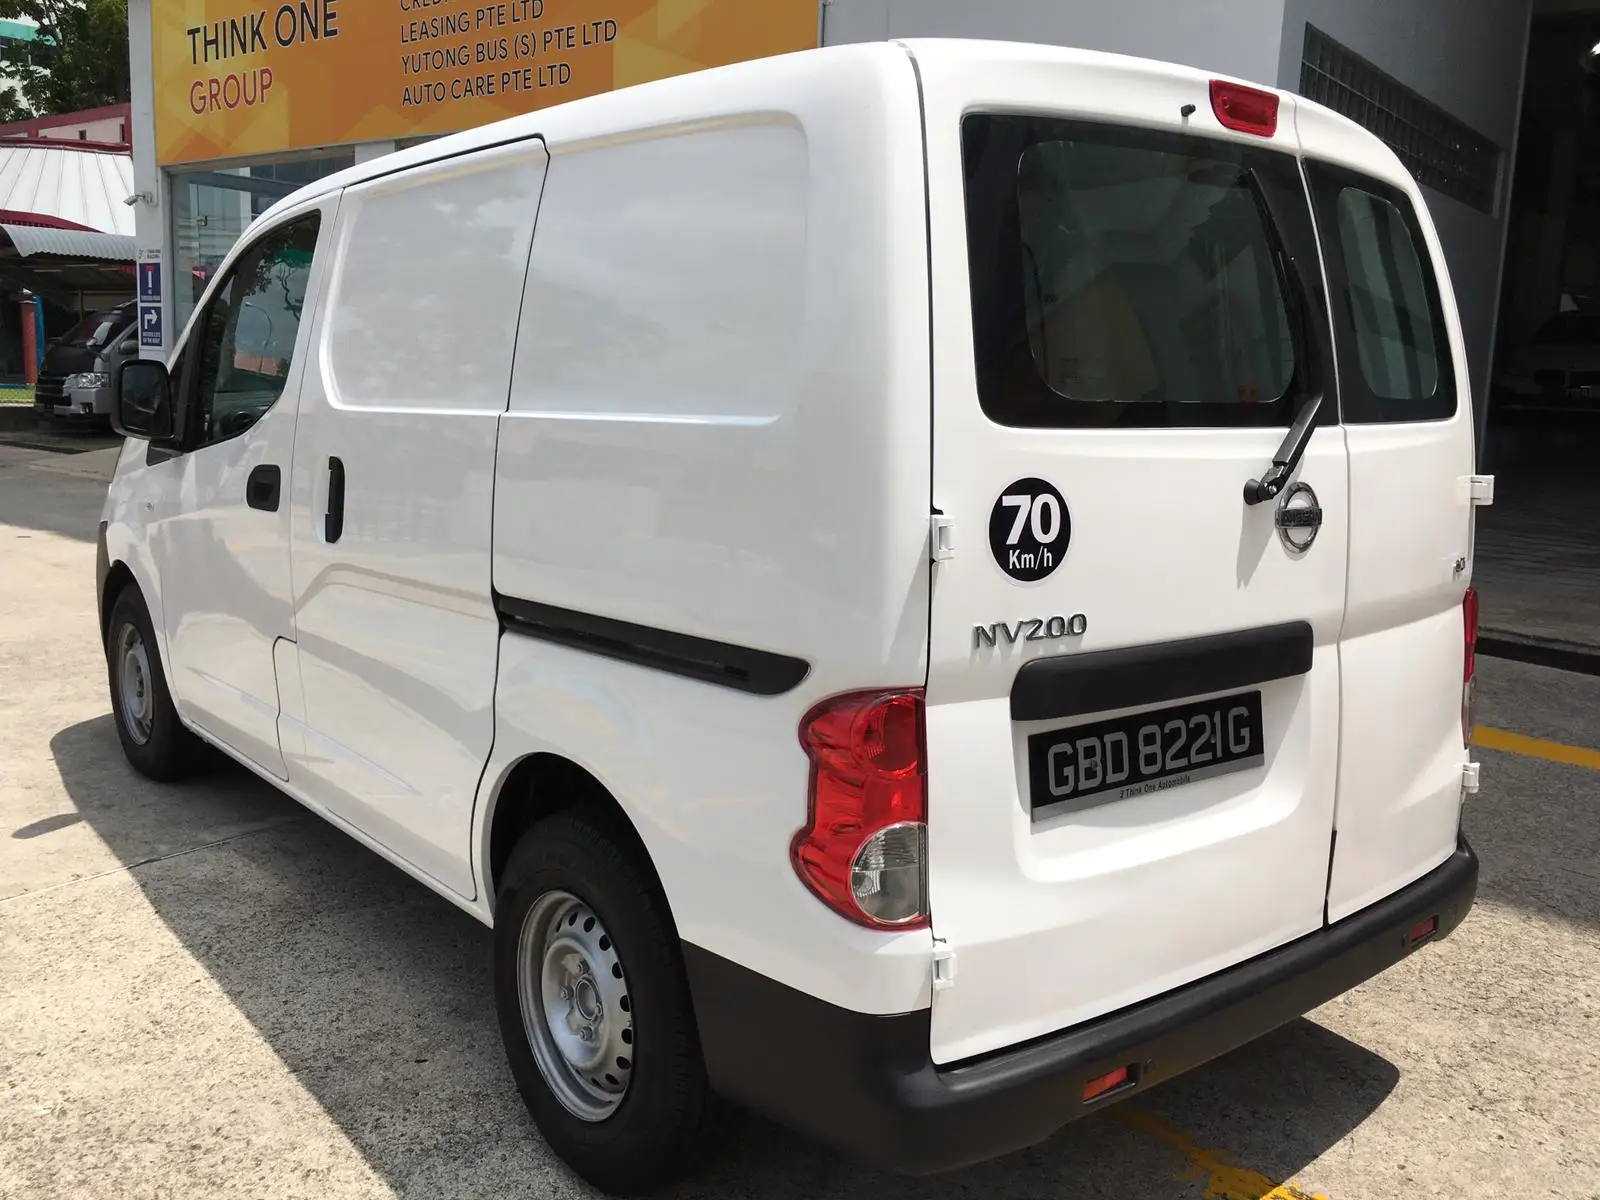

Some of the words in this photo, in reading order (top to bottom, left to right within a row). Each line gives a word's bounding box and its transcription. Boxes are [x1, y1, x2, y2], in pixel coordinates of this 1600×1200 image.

[187, 11, 267, 64] THINK
[275, 0, 338, 47] ONE
[401, 12, 470, 43] LEASING
[476, 5, 505, 29] PTE
[512, 0, 543, 22] LTD
[402, 46, 470, 74] YUTONG
[476, 38, 508, 63] BUS
[514, 33, 537, 59] (S)
[543, 27, 576, 51] PTE
[583, 20, 617, 46] LTD
[190, 68, 273, 115] GROUP
[402, 82, 446, 106] AUTO
[451, 74, 495, 99] CARE
[501, 69, 532, 93] PTE
[539, 63, 571, 87] LTD
[1002, 493, 1061, 545] 70
[1009, 546, 1053, 570] Km/h
[974, 613, 1088, 649] NV200
[1048, 731, 1129, 796] GBD
